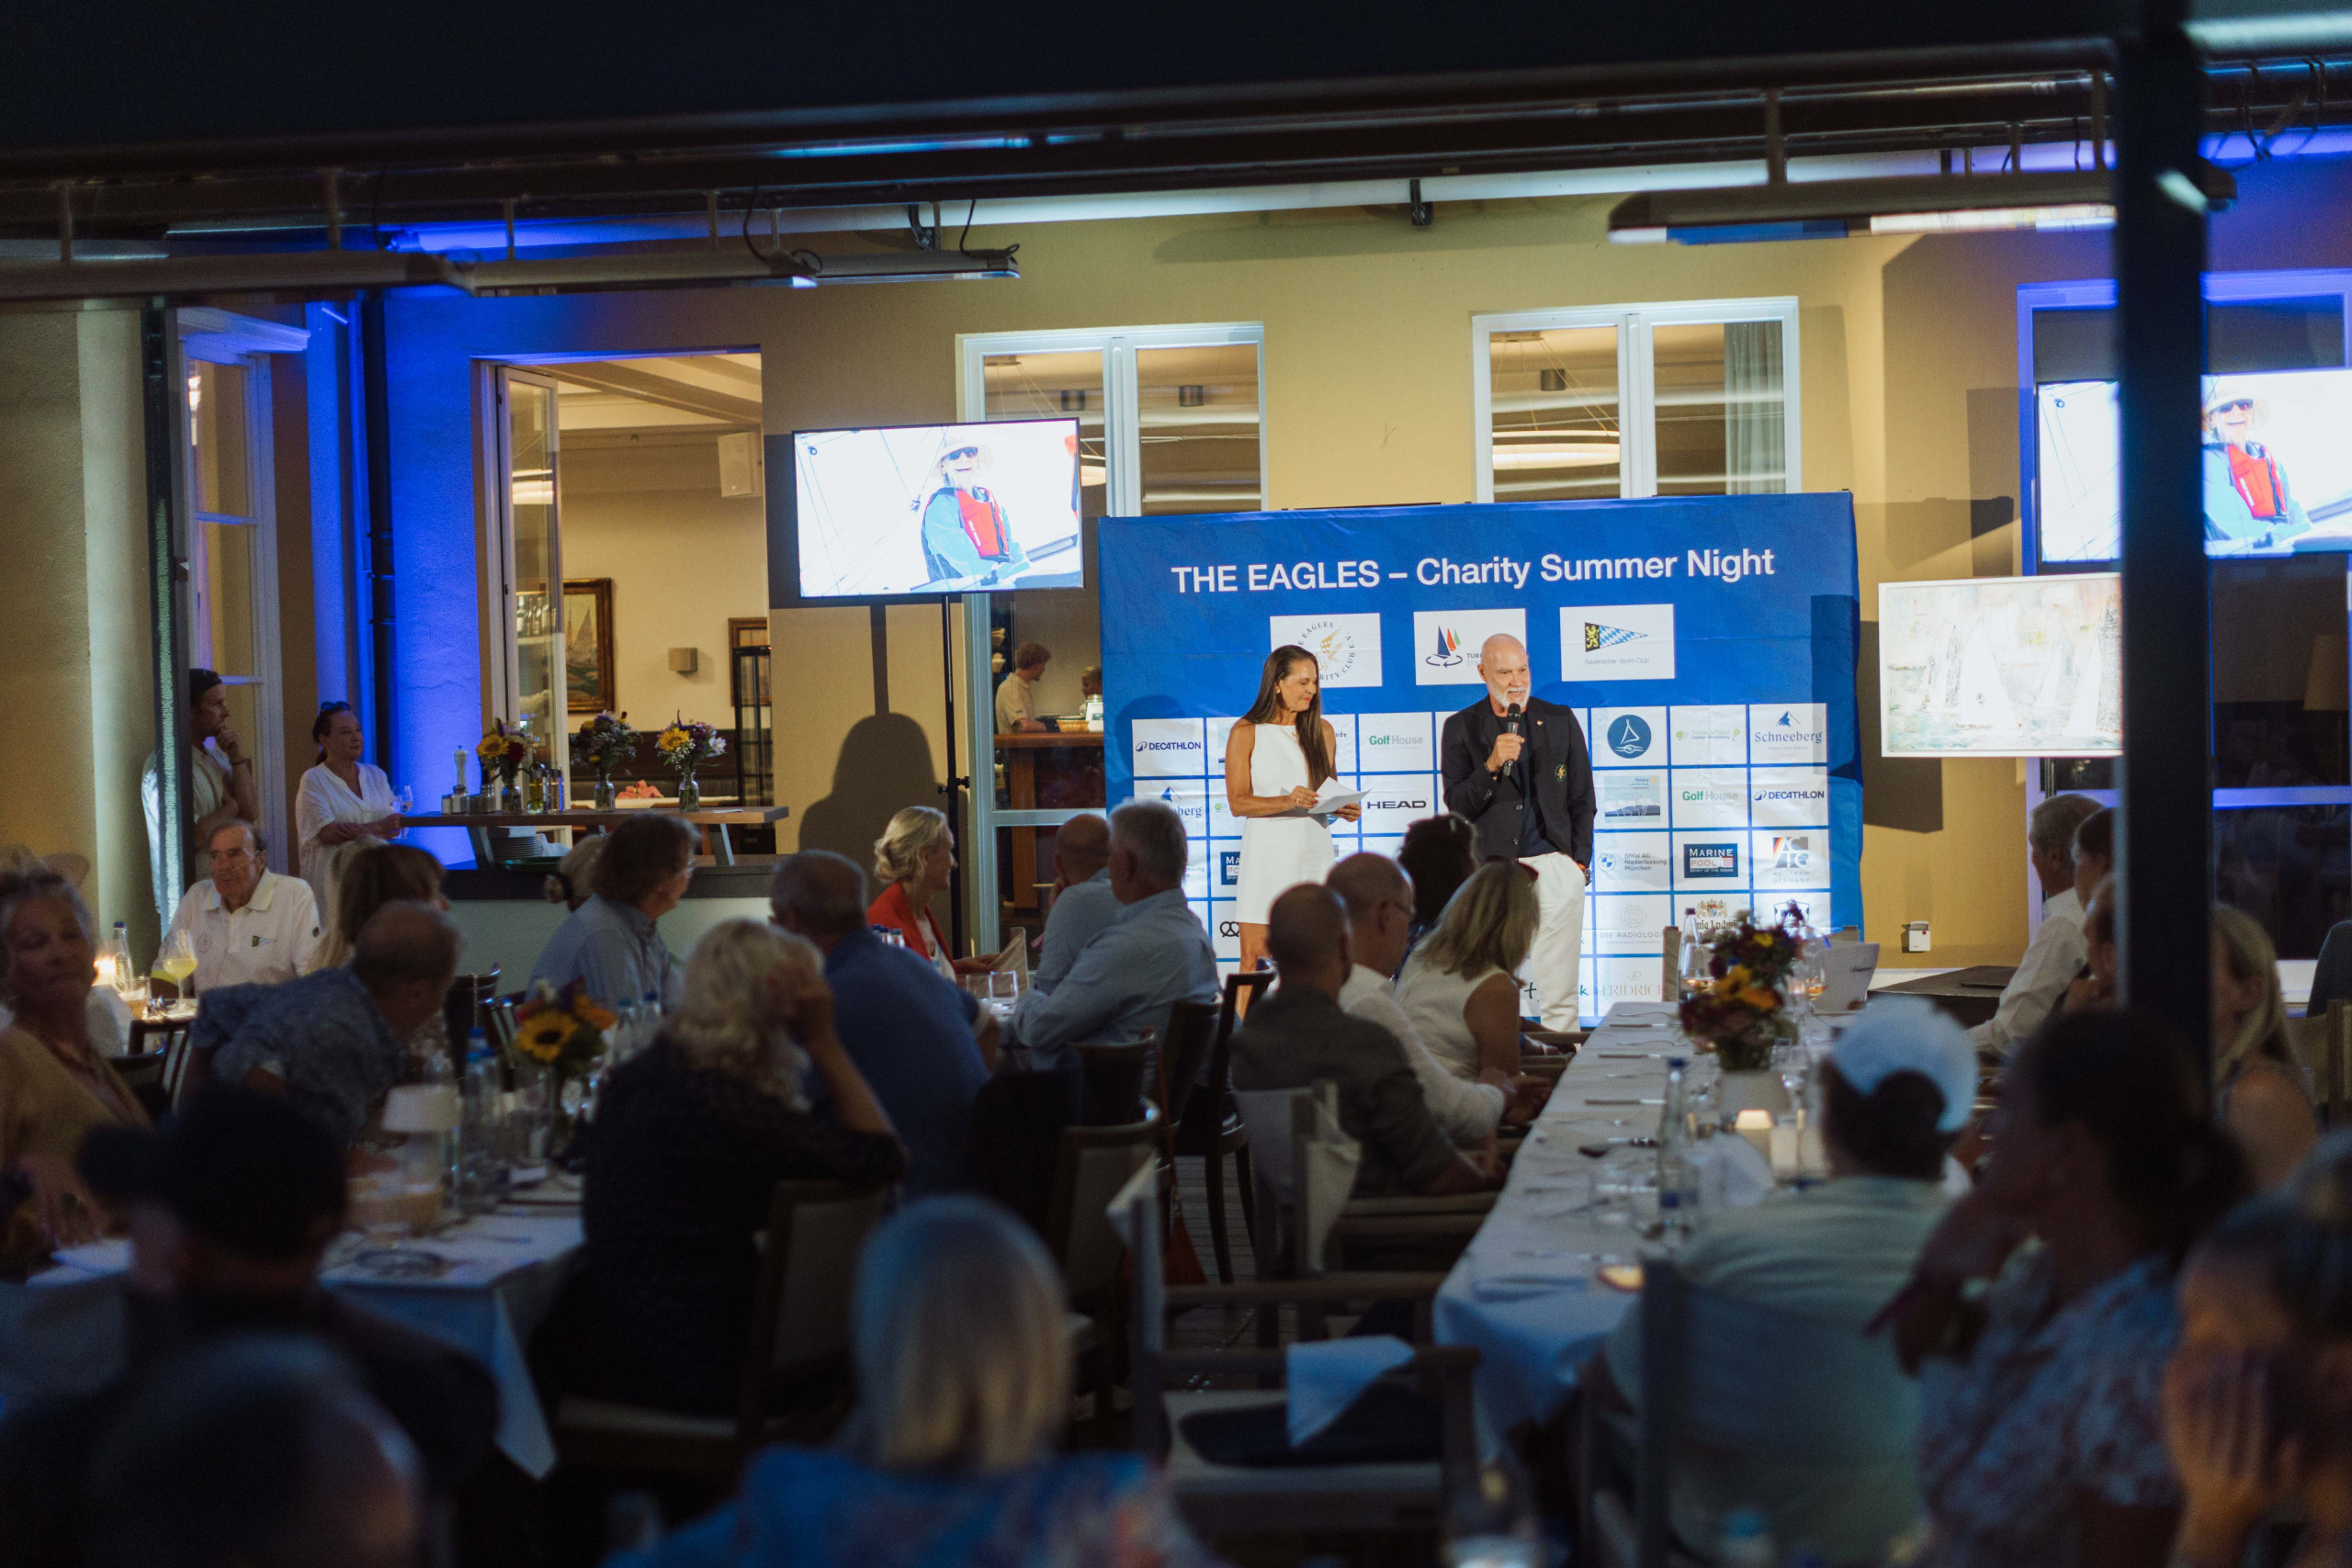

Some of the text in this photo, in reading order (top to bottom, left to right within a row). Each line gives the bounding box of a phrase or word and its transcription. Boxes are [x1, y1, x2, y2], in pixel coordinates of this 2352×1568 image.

[1170, 565, 1238, 593] THE
[1248, 558, 1380, 591] EAGLES
[1416, 555, 1531, 590] Charity
[1540, 552, 1678, 581] Summer
[1687, 547, 1775, 583] Night
[1301, 621, 1334, 638] EAGLES
[1319, 671, 1340, 681] RITY
[1755, 731, 1823, 744] Schneeberg
[1148, 741, 1202, 750] DECATHLON
[1768, 790, 1825, 800] DECATHLON
[1367, 800, 1427, 809] HEAD
[1689, 848, 1733, 857] MARINE
